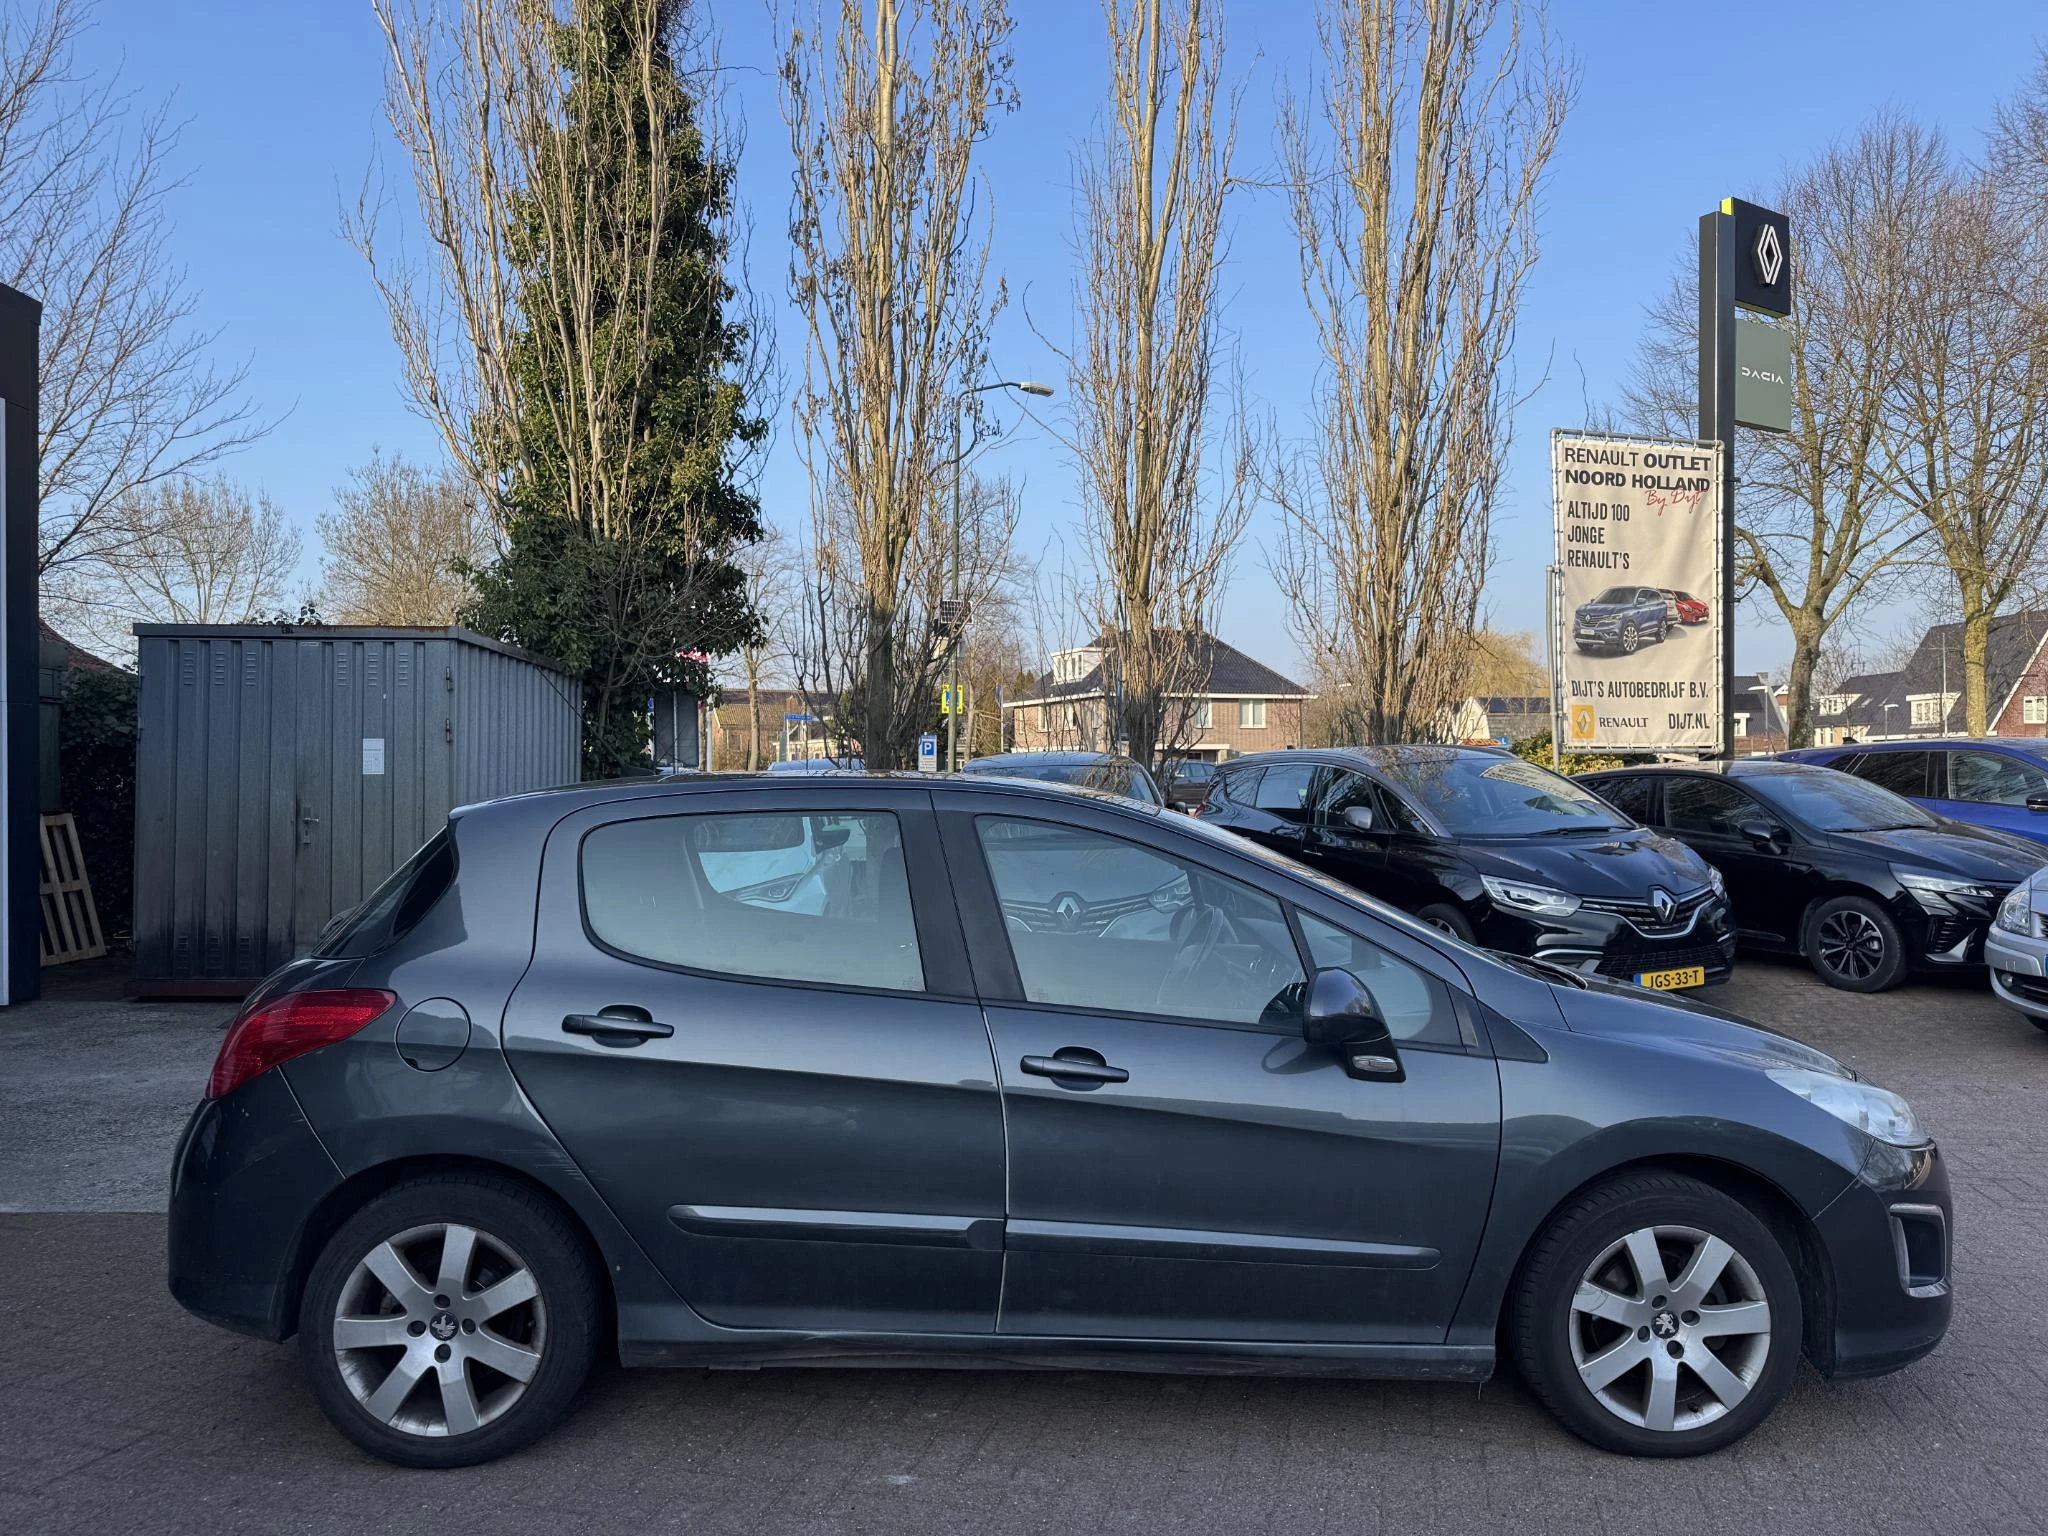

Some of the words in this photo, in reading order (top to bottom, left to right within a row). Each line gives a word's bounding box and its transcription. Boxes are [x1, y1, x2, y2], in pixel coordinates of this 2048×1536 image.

[1741, 366, 1784, 384] DACIA
[1565, 447, 1639, 467] RENAULT
[1643, 453, 1711, 471] OUTLET
[1565, 469, 1626, 487] NOORD
[1631, 474, 1710, 492] HOLLAND
[1567, 501, 1608, 520] ALTIJD
[1611, 504, 1630, 521] 100
[1645, 489, 1668, 517] By
[1567, 525, 1605, 544] JONGE
[1567, 549, 1630, 569] RENAULT'S
[1571, 680, 1604, 697] DIJT'S
[1608, 681, 1685, 698] AUTOBEDRIJF
[1689, 681, 1709, 698] B.V.
[1599, 717, 1648, 728] RENAULT
[1668, 713, 1710, 729] DIJT.NL
[924, 742, 932, 755] P
[1650, 970, 1699, 988] JGS-33-T
